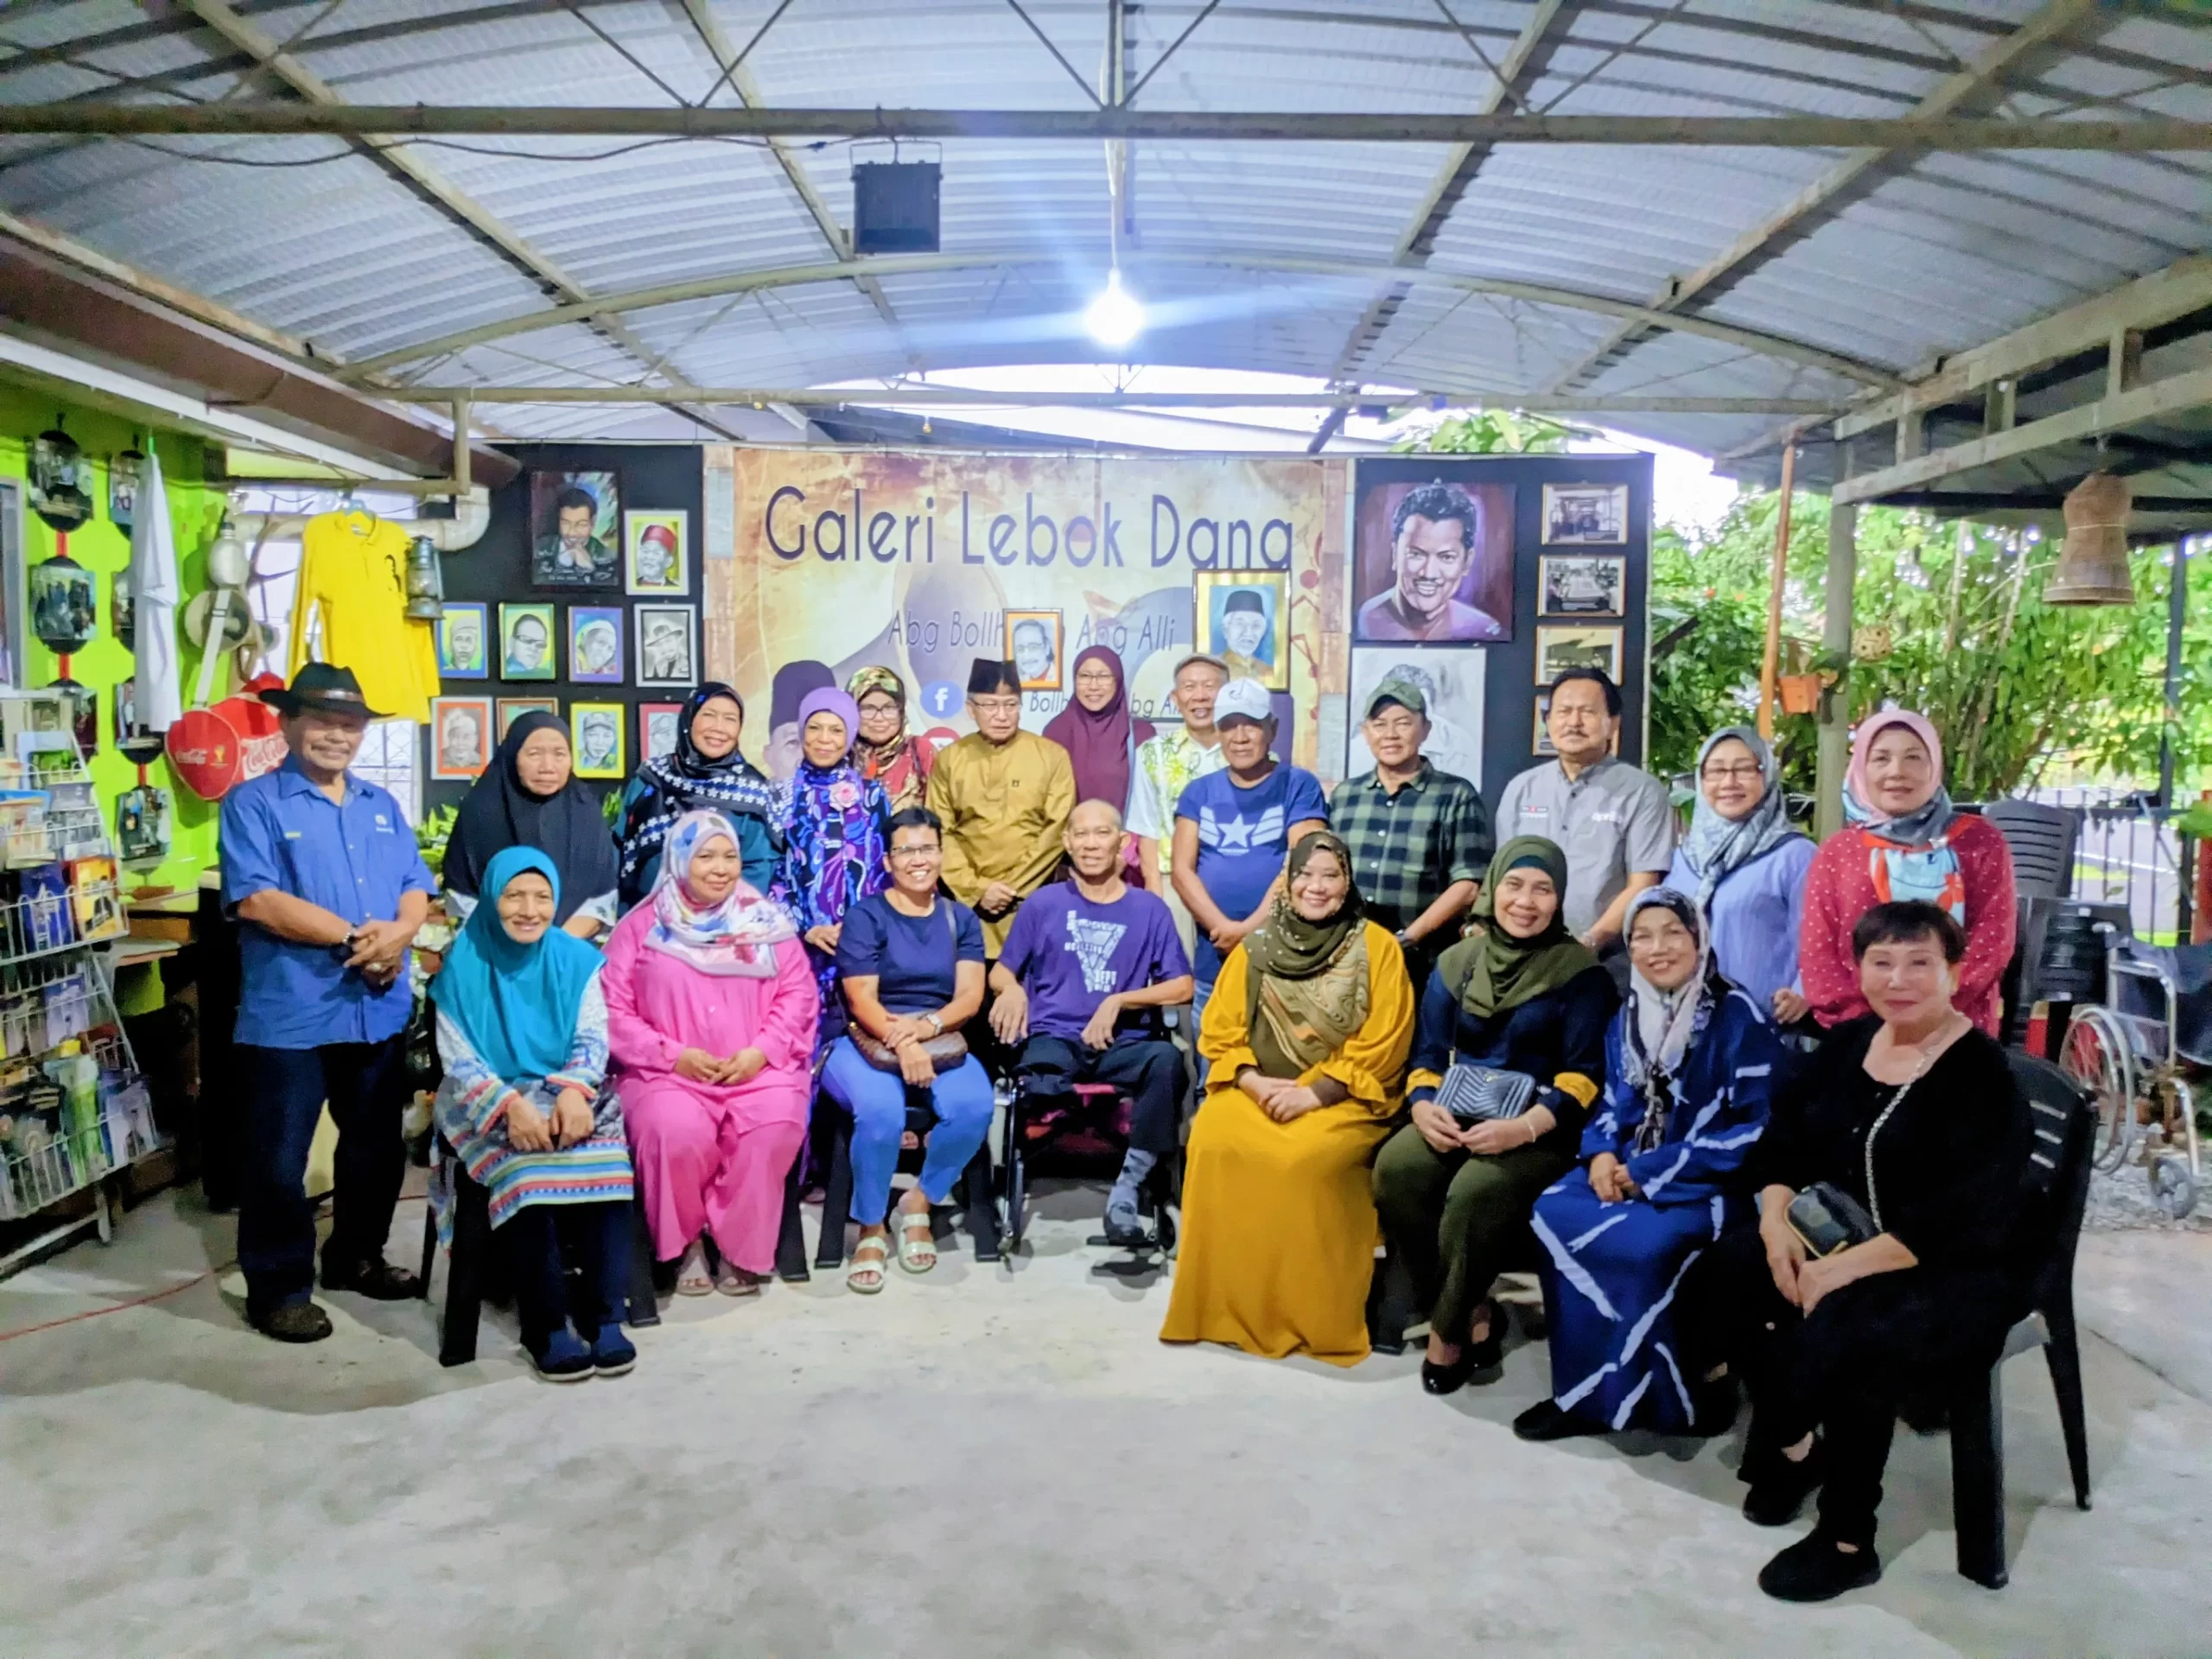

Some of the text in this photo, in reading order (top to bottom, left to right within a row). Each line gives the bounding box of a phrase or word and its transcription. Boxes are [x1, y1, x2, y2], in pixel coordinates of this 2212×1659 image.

[766, 486, 934, 563] Galeri
[962, 491, 1124, 568] Lebok
[888, 610, 939, 653] Abg
[1076, 613, 1128, 657] Abg
[1137, 614, 1175, 651] Alli
